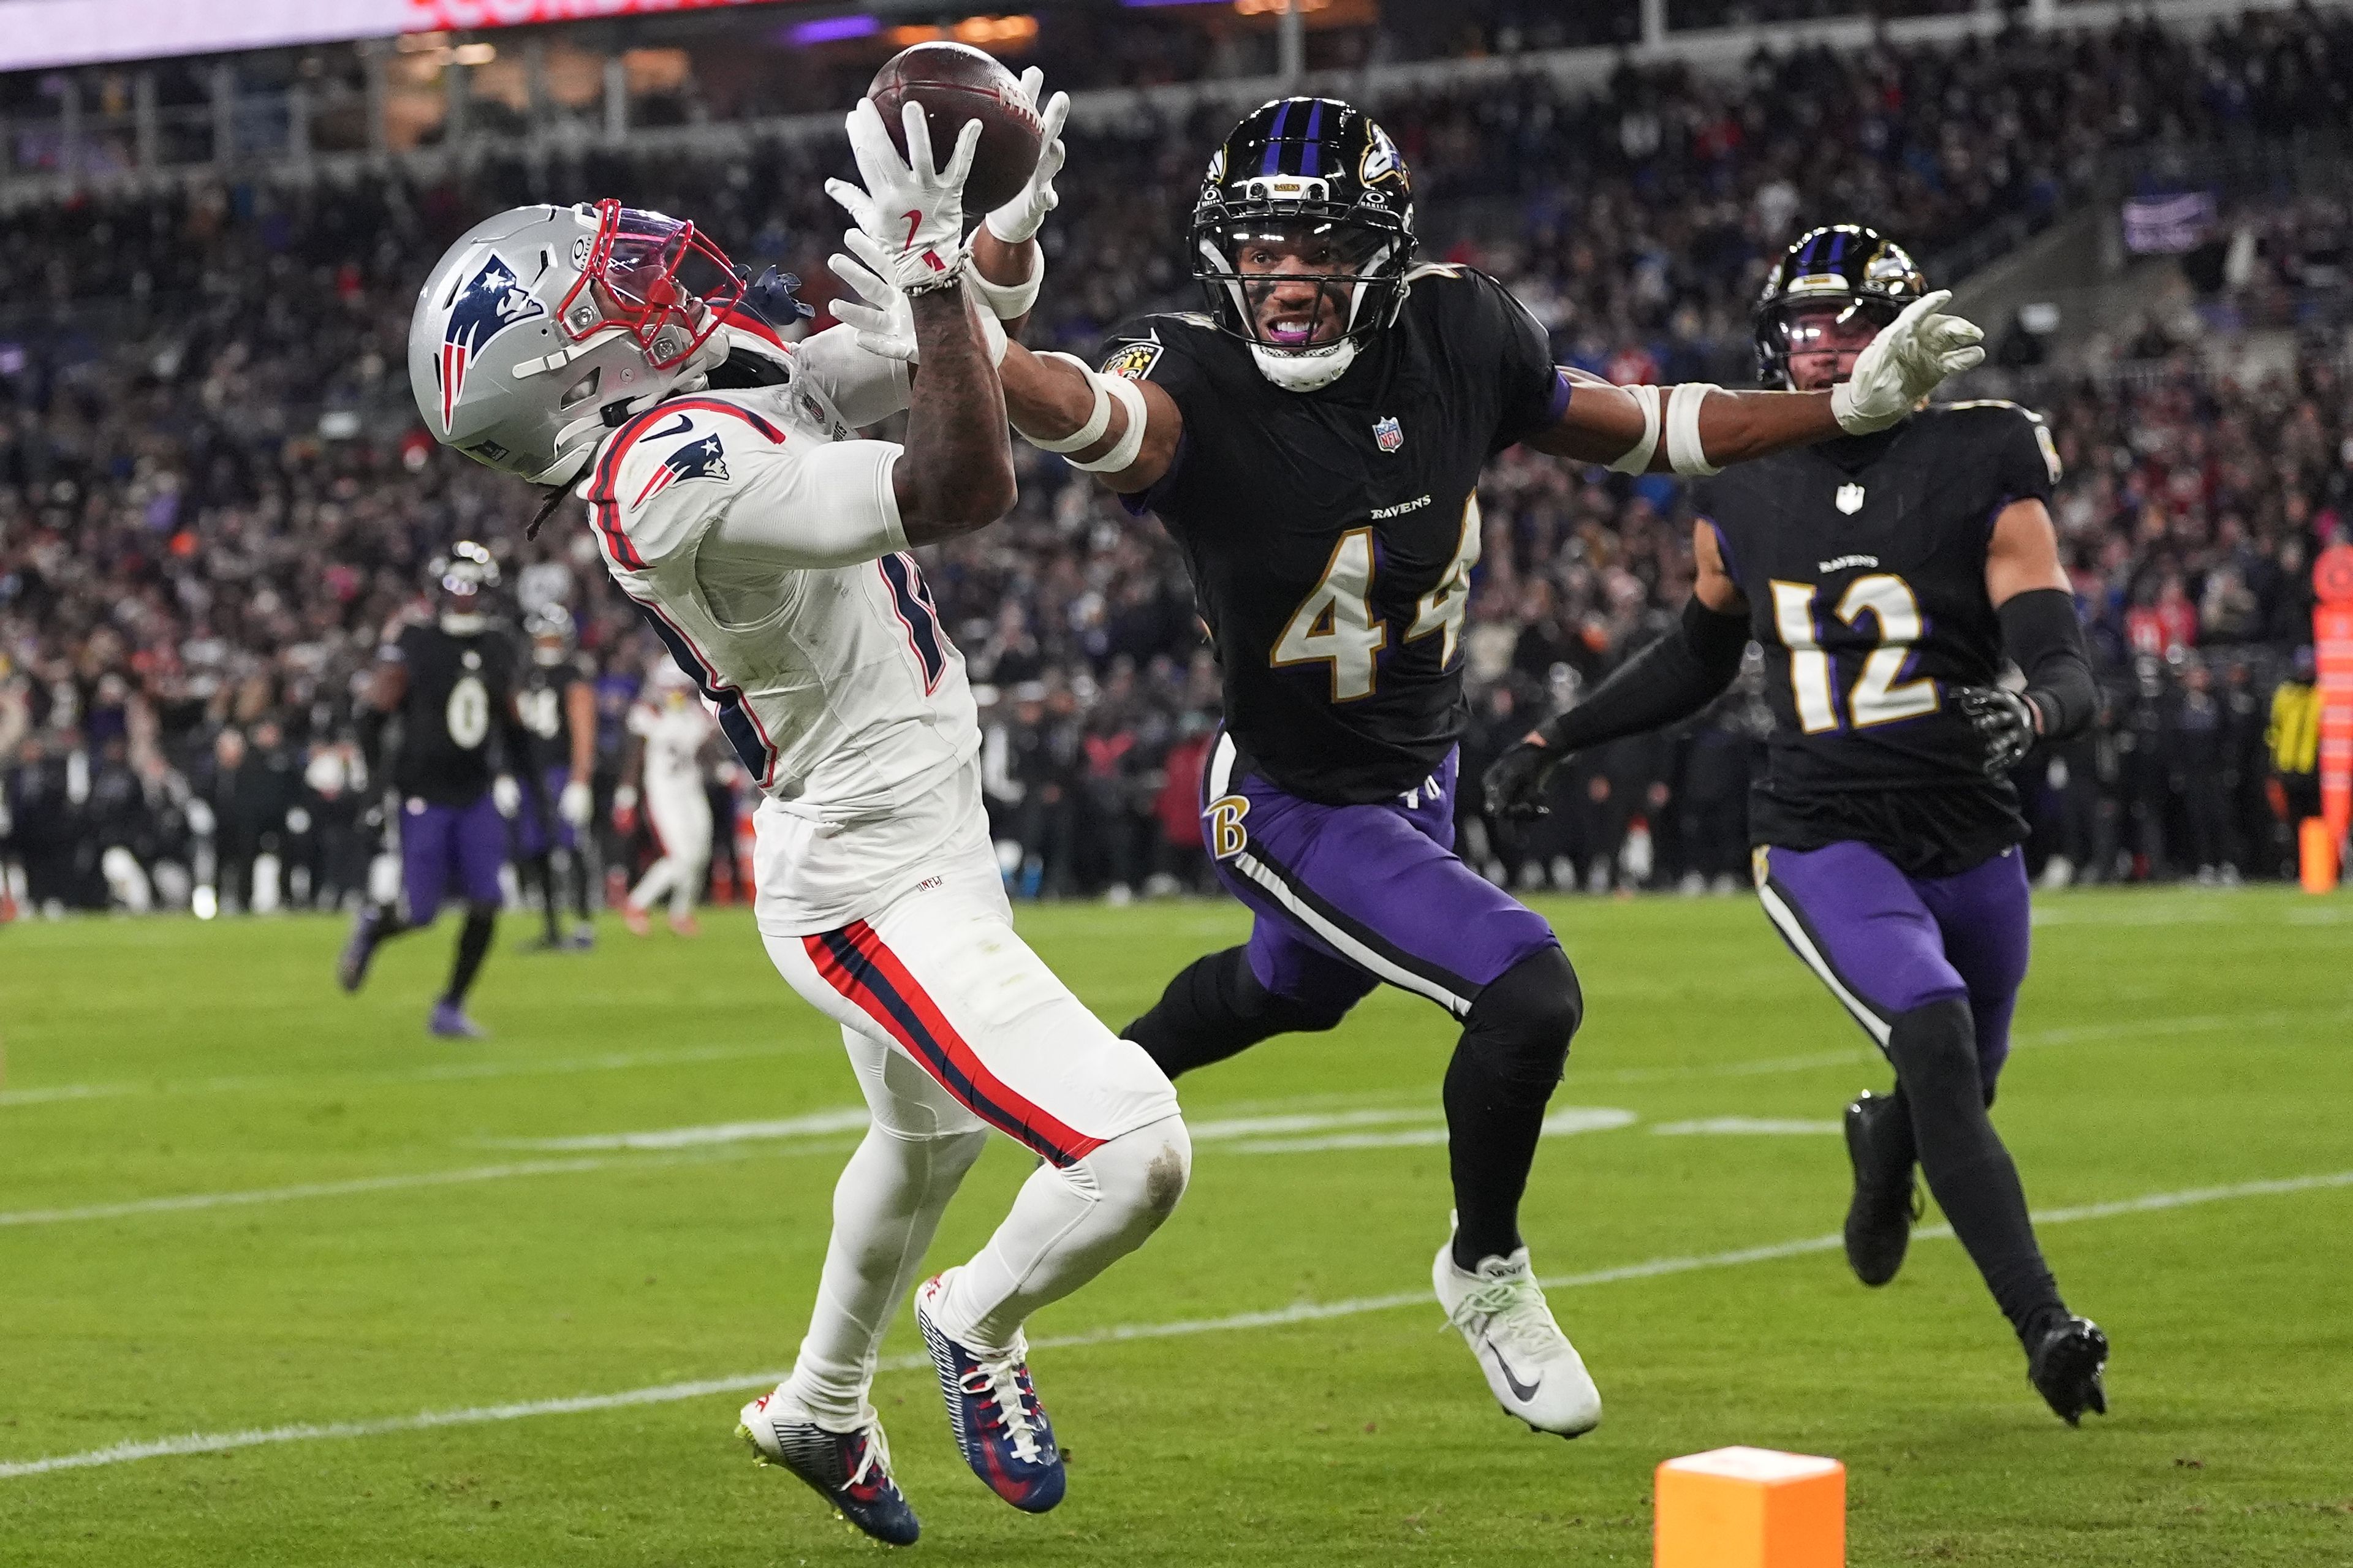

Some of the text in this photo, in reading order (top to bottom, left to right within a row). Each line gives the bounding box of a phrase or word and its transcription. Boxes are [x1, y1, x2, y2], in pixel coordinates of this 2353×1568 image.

[1381, 431, 1401, 447] NFL
[1370, 494, 1431, 520] RAVENS
[1270, 486, 1482, 703] 44
[1769, 573, 1941, 735] 12
[446, 676, 490, 750] 0
[1201, 795, 1251, 860] B
